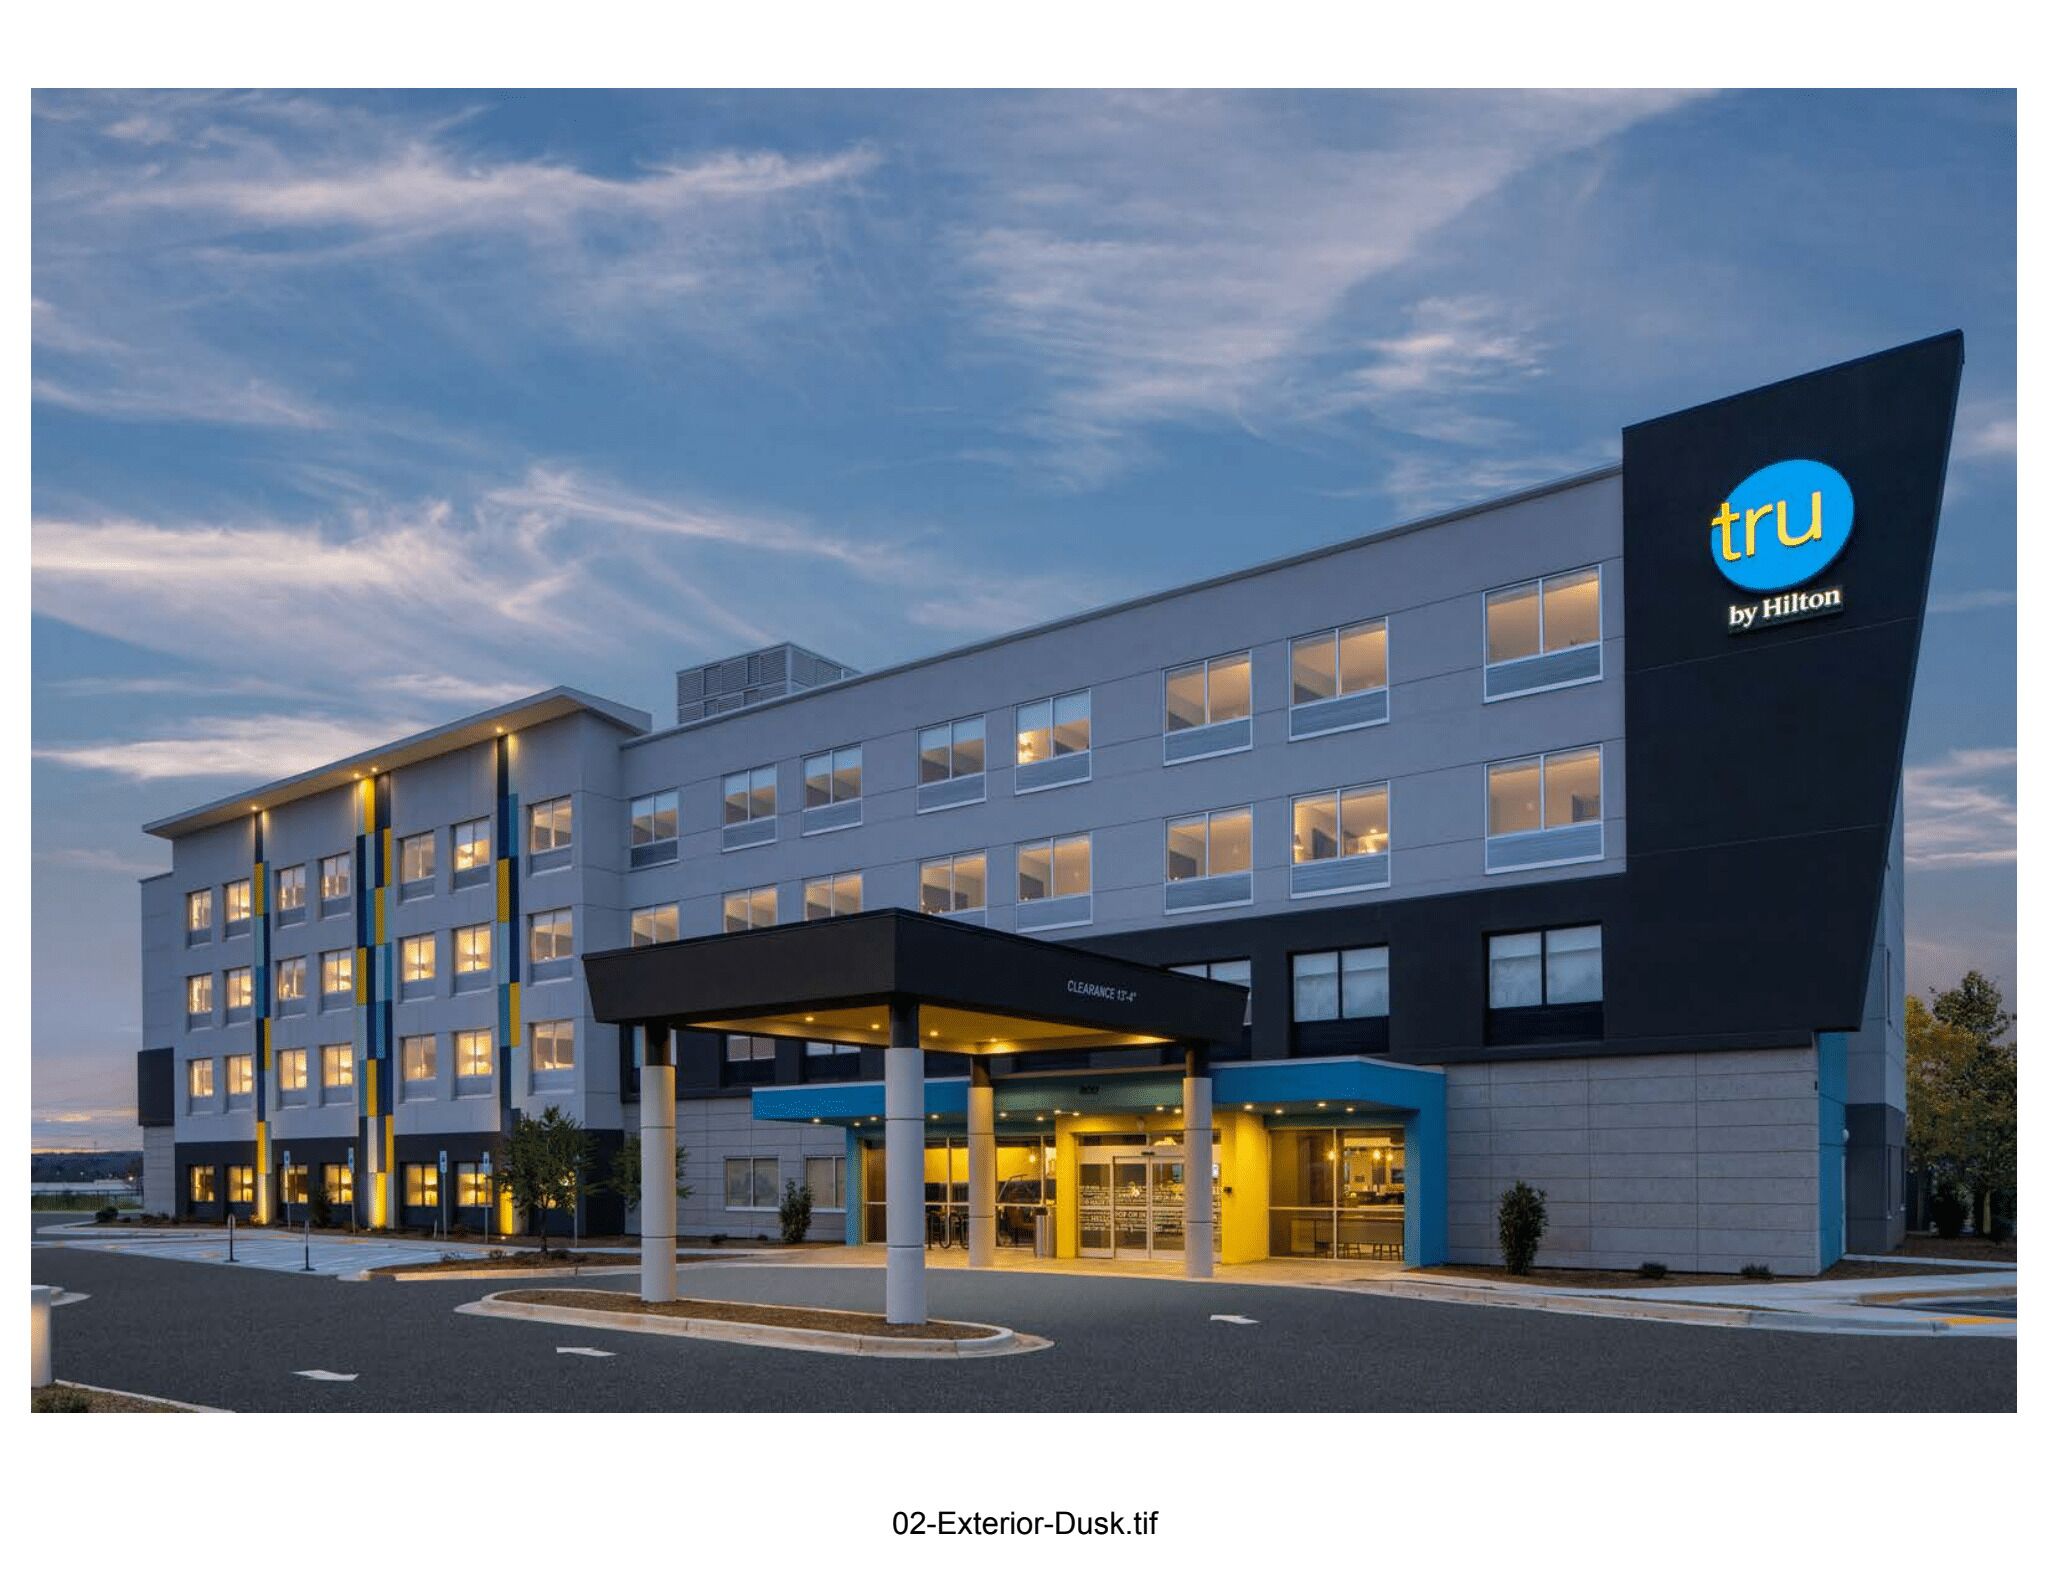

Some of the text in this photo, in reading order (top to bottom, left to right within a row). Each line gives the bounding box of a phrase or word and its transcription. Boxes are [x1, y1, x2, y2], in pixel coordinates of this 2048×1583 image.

[1711, 490, 1822, 561] tru
[1728, 588, 1841, 627] by Hilton
[1067, 980, 1115, 1000] CLEARANCE
